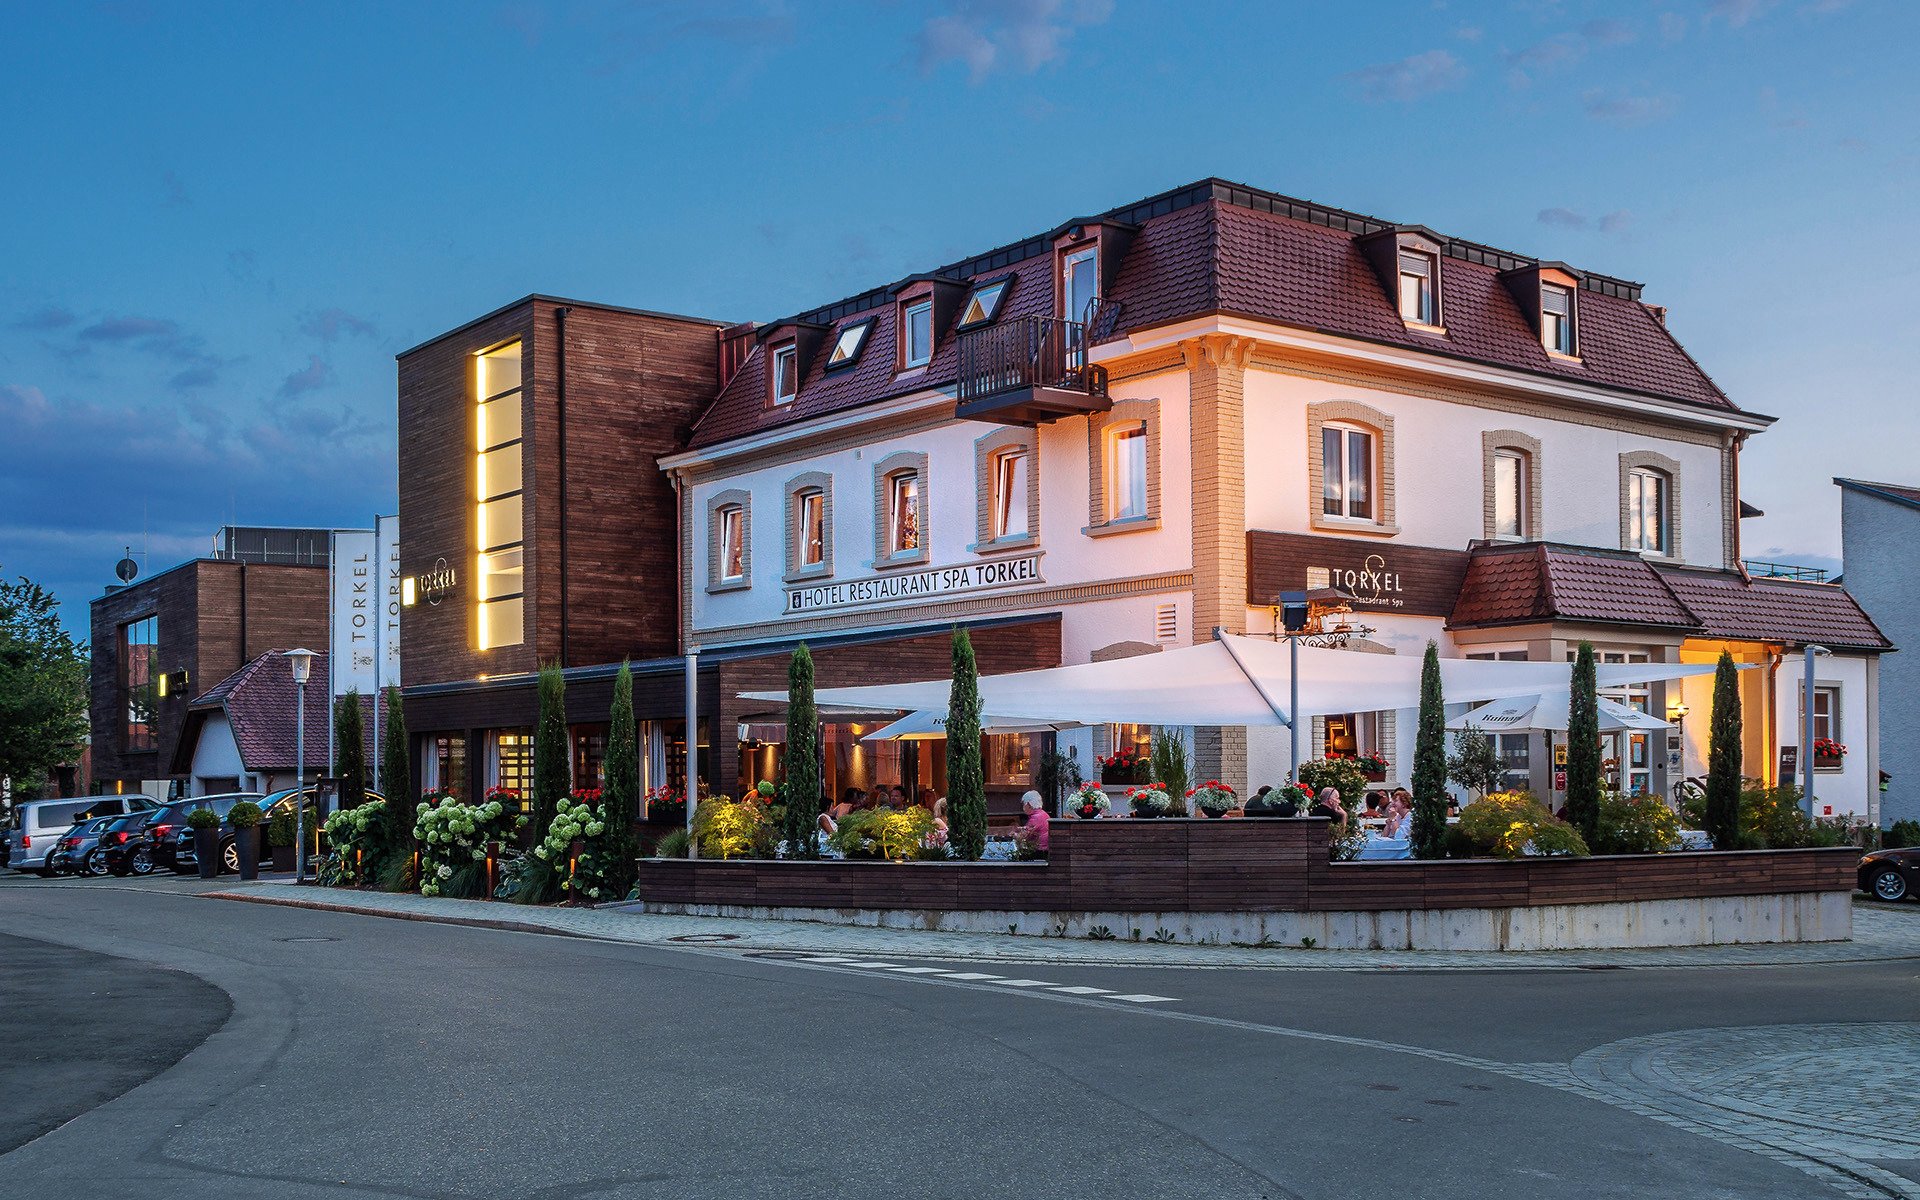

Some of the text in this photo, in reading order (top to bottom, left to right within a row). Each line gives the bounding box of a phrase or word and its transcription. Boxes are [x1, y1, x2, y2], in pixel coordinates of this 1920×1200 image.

[352, 553, 367, 643] TORKEL
[803, 559, 1036, 608] HOTEL RESTAURANT SPA TORKEL
[1333, 568, 1403, 592] TORKEL
[1392, 598, 1404, 608] Spa
